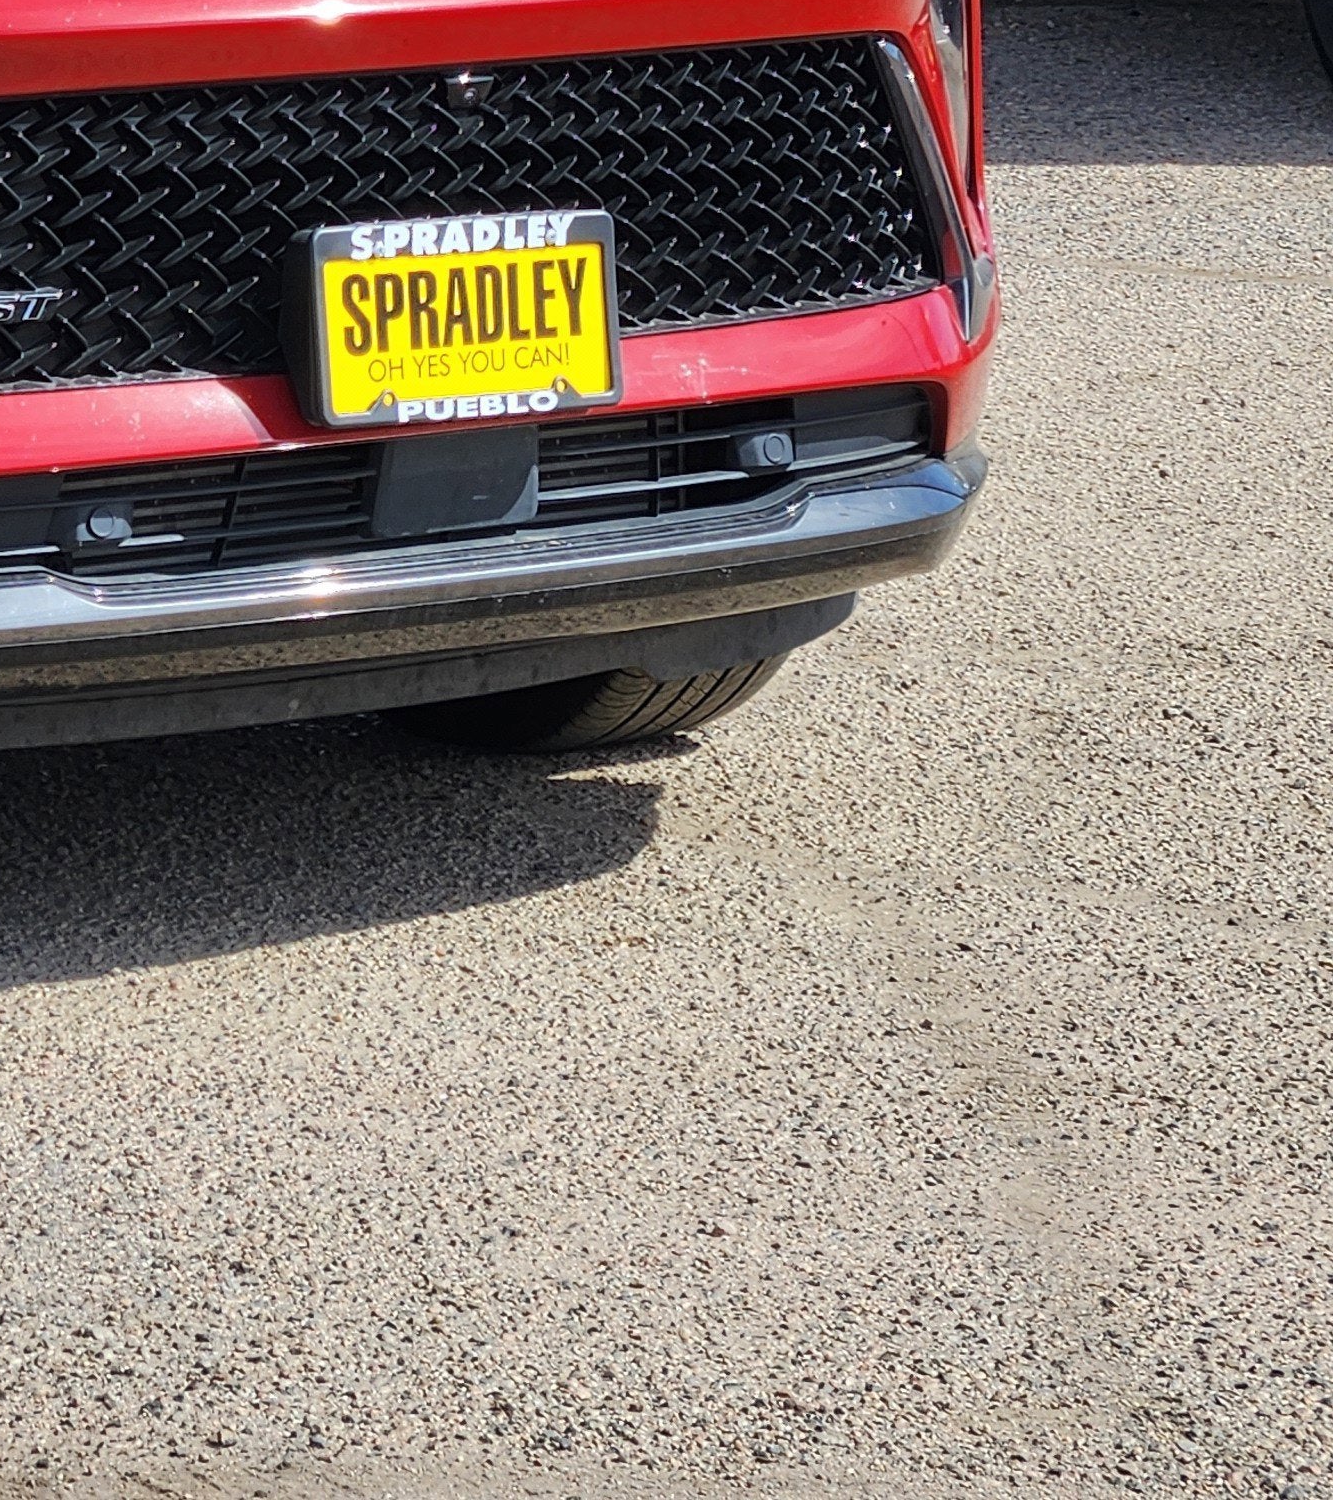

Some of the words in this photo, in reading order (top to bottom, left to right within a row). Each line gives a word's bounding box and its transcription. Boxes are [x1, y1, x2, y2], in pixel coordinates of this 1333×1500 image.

[350, 212, 576, 260] SPRADLEY
[341, 257, 587, 357] SPRADLEY
[368, 360, 405, 383] OH
[413, 354, 451, 379] YES
[461, 349, 506, 375] YOU
[514, 342, 571, 370] CAN!
[397, 391, 559, 424] PUEBLO
